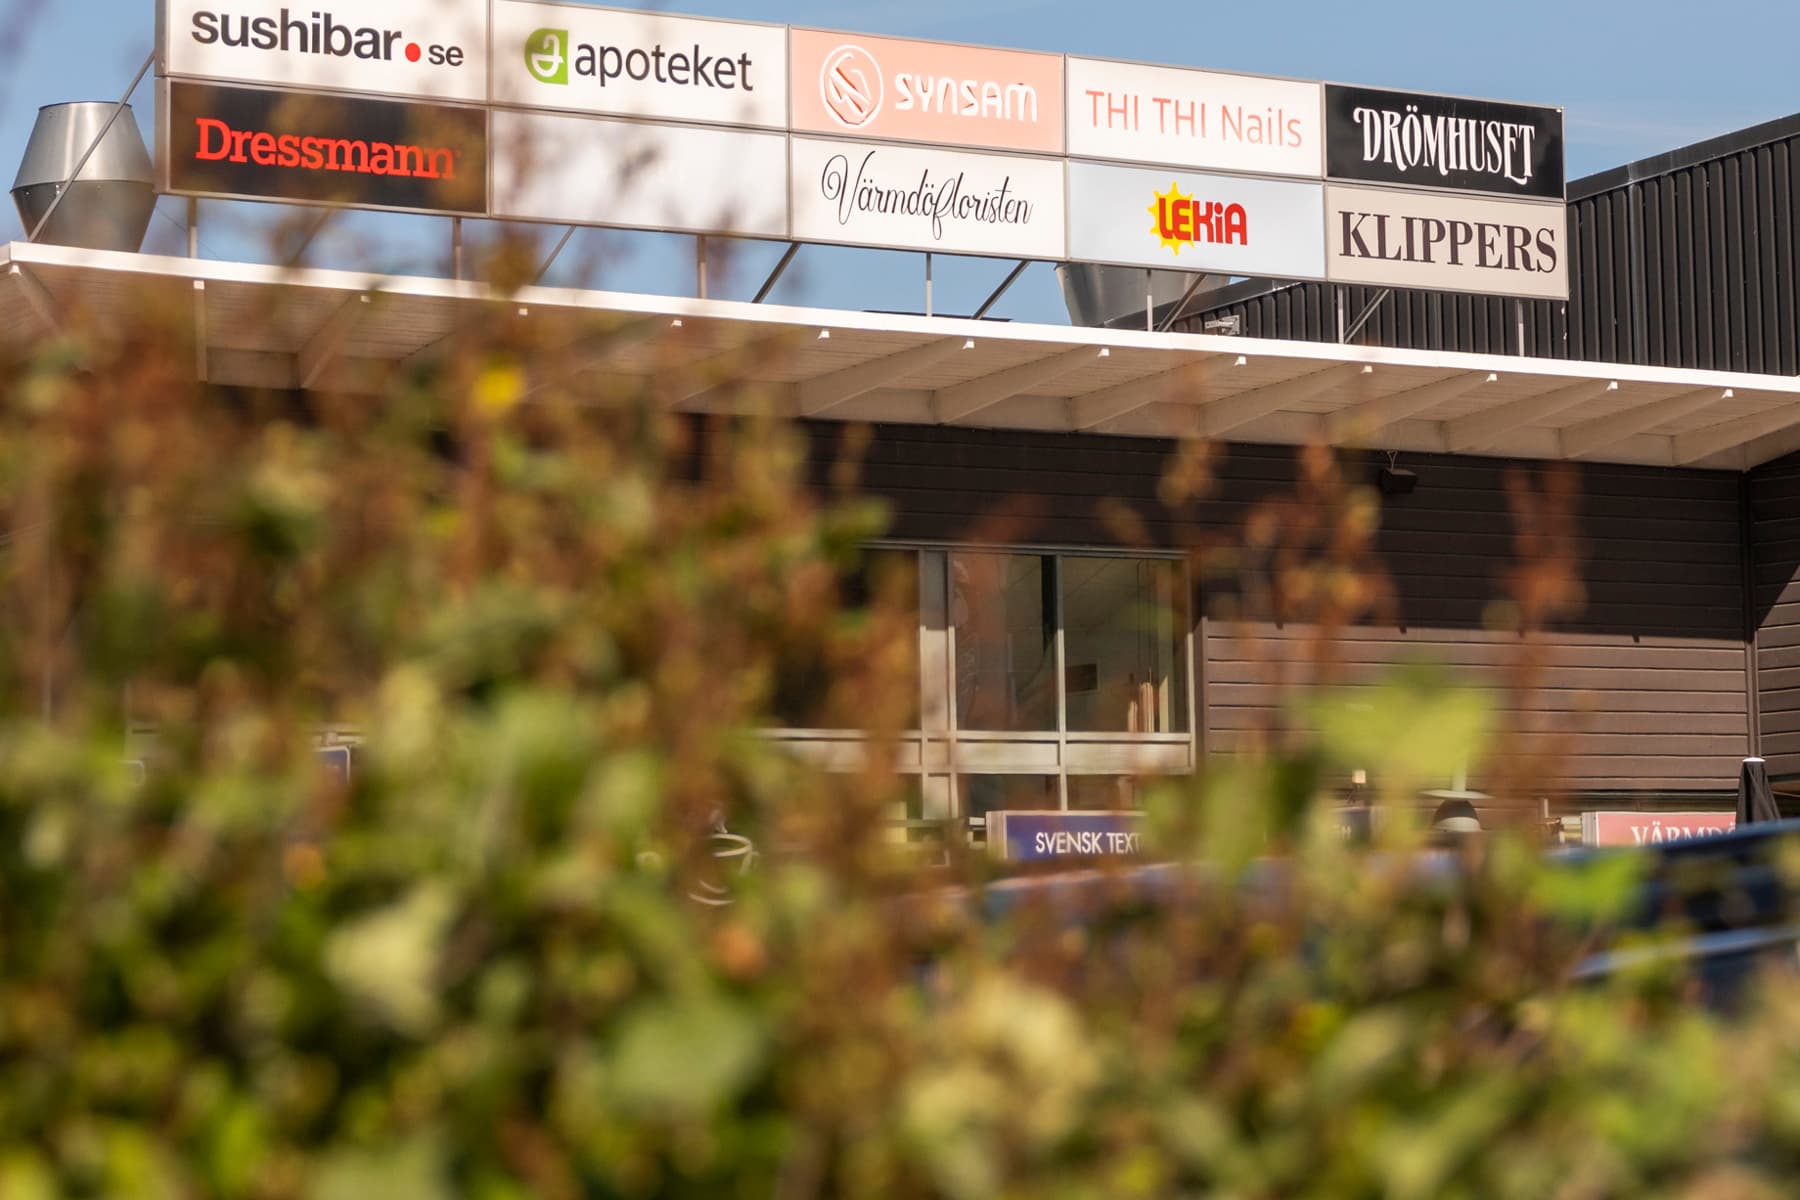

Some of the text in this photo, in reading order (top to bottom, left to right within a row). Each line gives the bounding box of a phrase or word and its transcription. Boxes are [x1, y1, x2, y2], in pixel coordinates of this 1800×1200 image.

[575, 43, 754, 92] apoteket
[194, 117, 456, 179] Dressmann
[1085, 89, 1302, 149] THI THI Nails
[1353, 104, 1536, 186] DRÖMHUSET
[821, 150, 1033, 240] Värmdöfloristen
[1338, 210, 1558, 273] KLIPPERS
[1036, 831, 1103, 854] SVENSK
